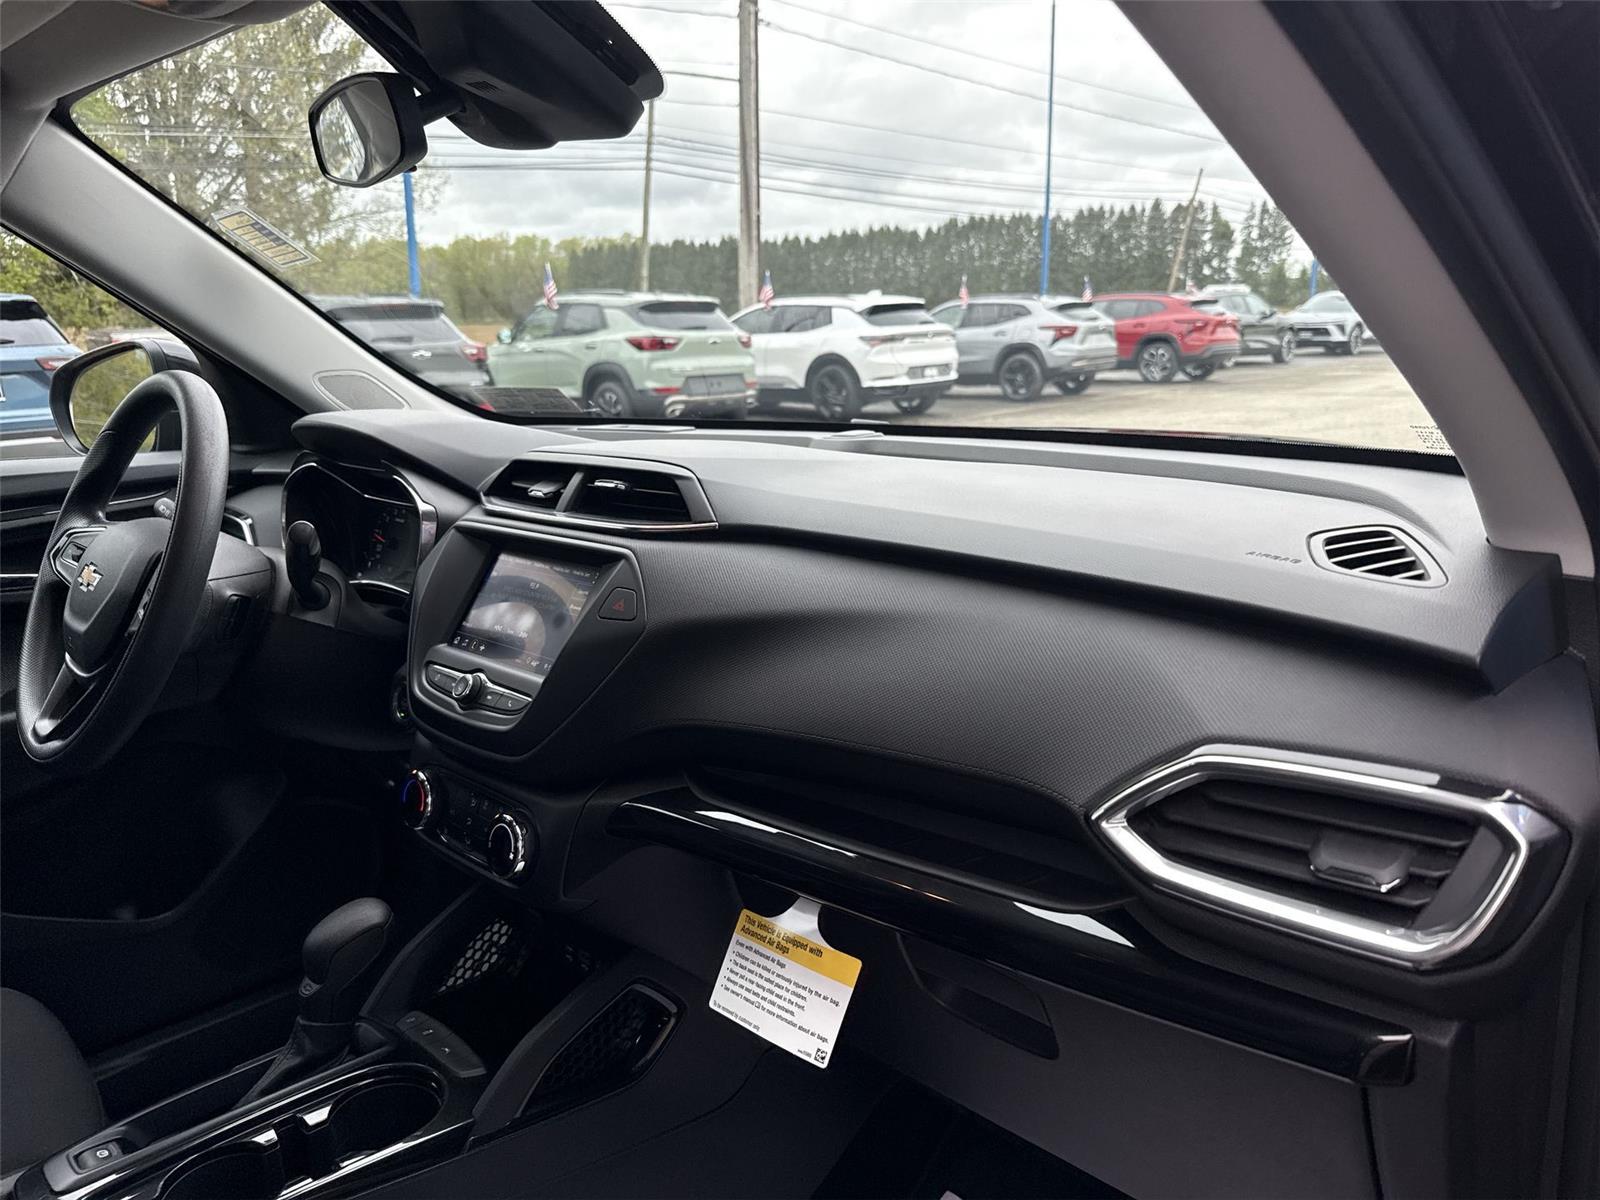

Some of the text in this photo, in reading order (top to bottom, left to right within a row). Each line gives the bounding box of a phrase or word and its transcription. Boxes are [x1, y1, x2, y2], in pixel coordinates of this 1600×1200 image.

[1245, 551, 1302, 564] AIRBAG
[740, 925, 789, 954] Advanced Air Bags
[745, 914, 756, 927] This
[756, 920, 775, 935] Vehicle
[782, 933, 808, 951] Equipped
[809, 947, 823, 957] with
